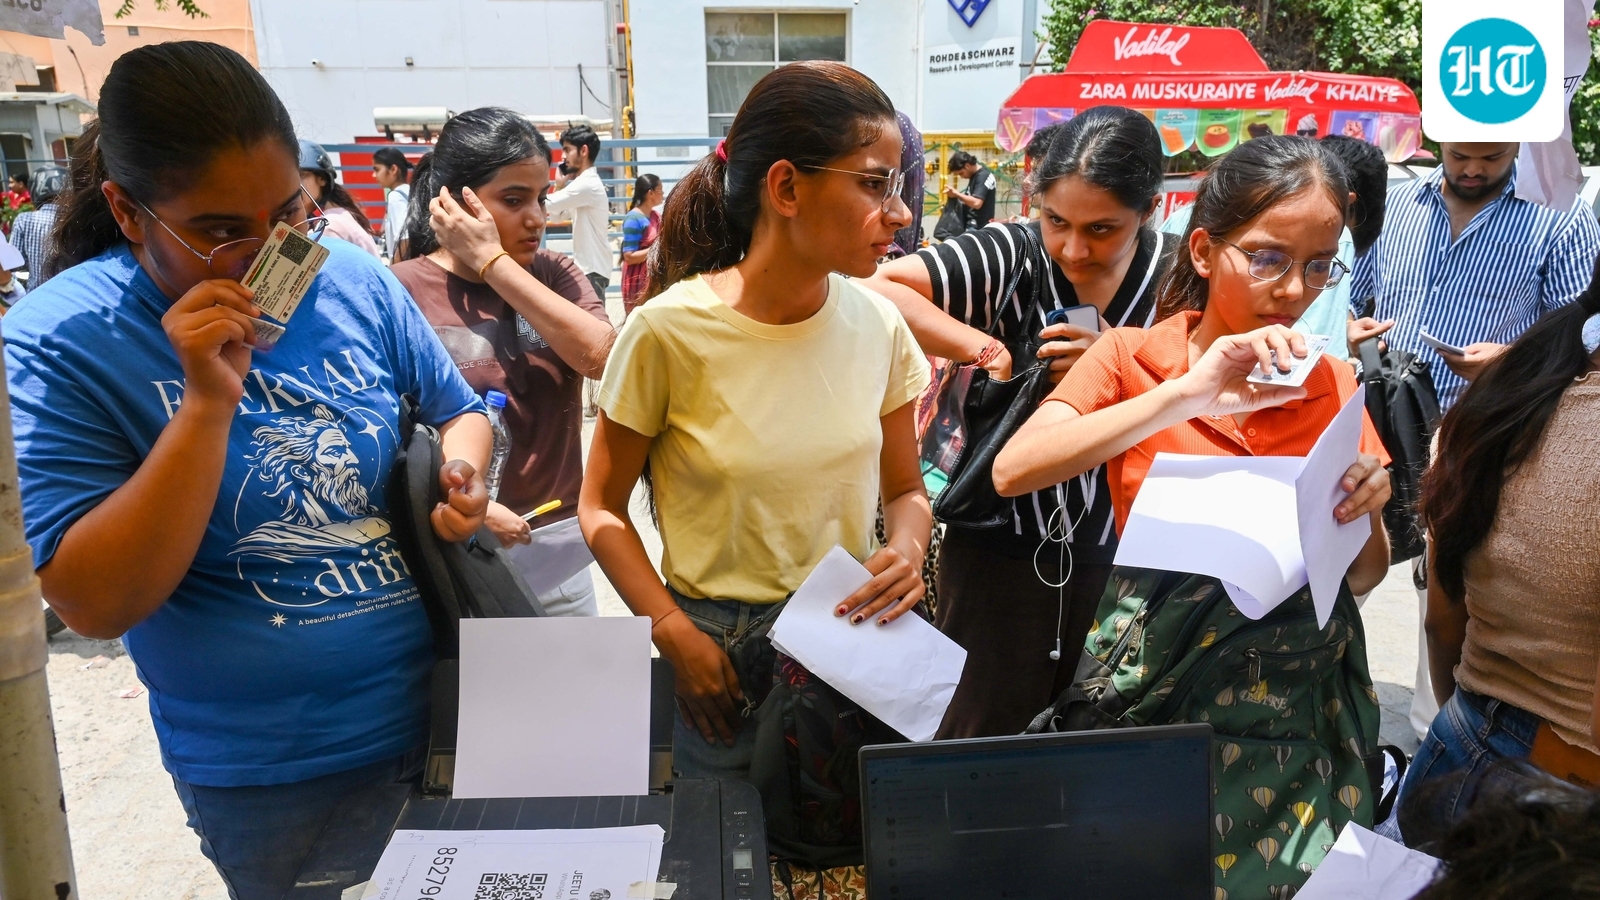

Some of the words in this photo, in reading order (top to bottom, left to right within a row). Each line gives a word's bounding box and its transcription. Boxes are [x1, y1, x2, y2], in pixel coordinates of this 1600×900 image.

[1114, 26, 1190, 66] Vadilal
[929, 65, 953, 74] Research
[954, 63, 958, 72] &
[958, 61, 994, 72] Development
[995, 59, 1014, 68] Center
[1079, 83, 1127, 99] ZARA
[1131, 82, 1257, 100] MUSKURAIYE
[1264, 78, 1319, 104] Vadilal
[1326, 84, 1401, 103] KHAIYE
[151, 350, 378, 420] EERNAL
[356, 595, 388, 607] Unchained
[389, 591, 402, 600] from
[402, 588, 410, 596] the
[305, 614, 336, 625] beautiful
[337, 606, 375, 620] detachment
[375, 602, 390, 611] from
[569, 870, 583, 895] JEETU
